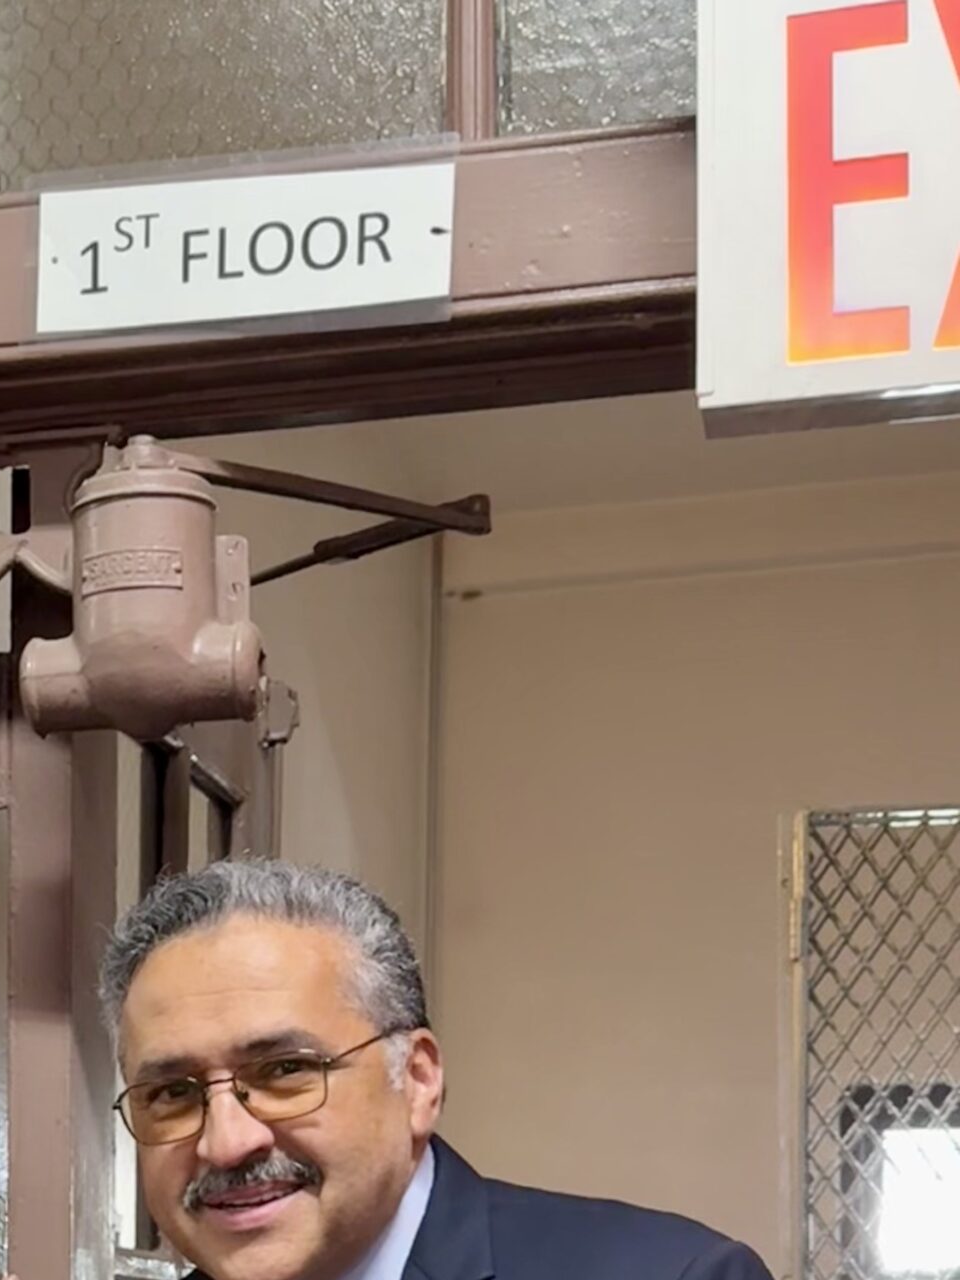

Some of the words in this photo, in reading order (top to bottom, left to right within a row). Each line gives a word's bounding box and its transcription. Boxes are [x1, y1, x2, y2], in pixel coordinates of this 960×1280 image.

[786, 0, 960, 366] E
[181, 211, 393, 283] FLOOR
[87, 551, 173, 581] SARGENT
